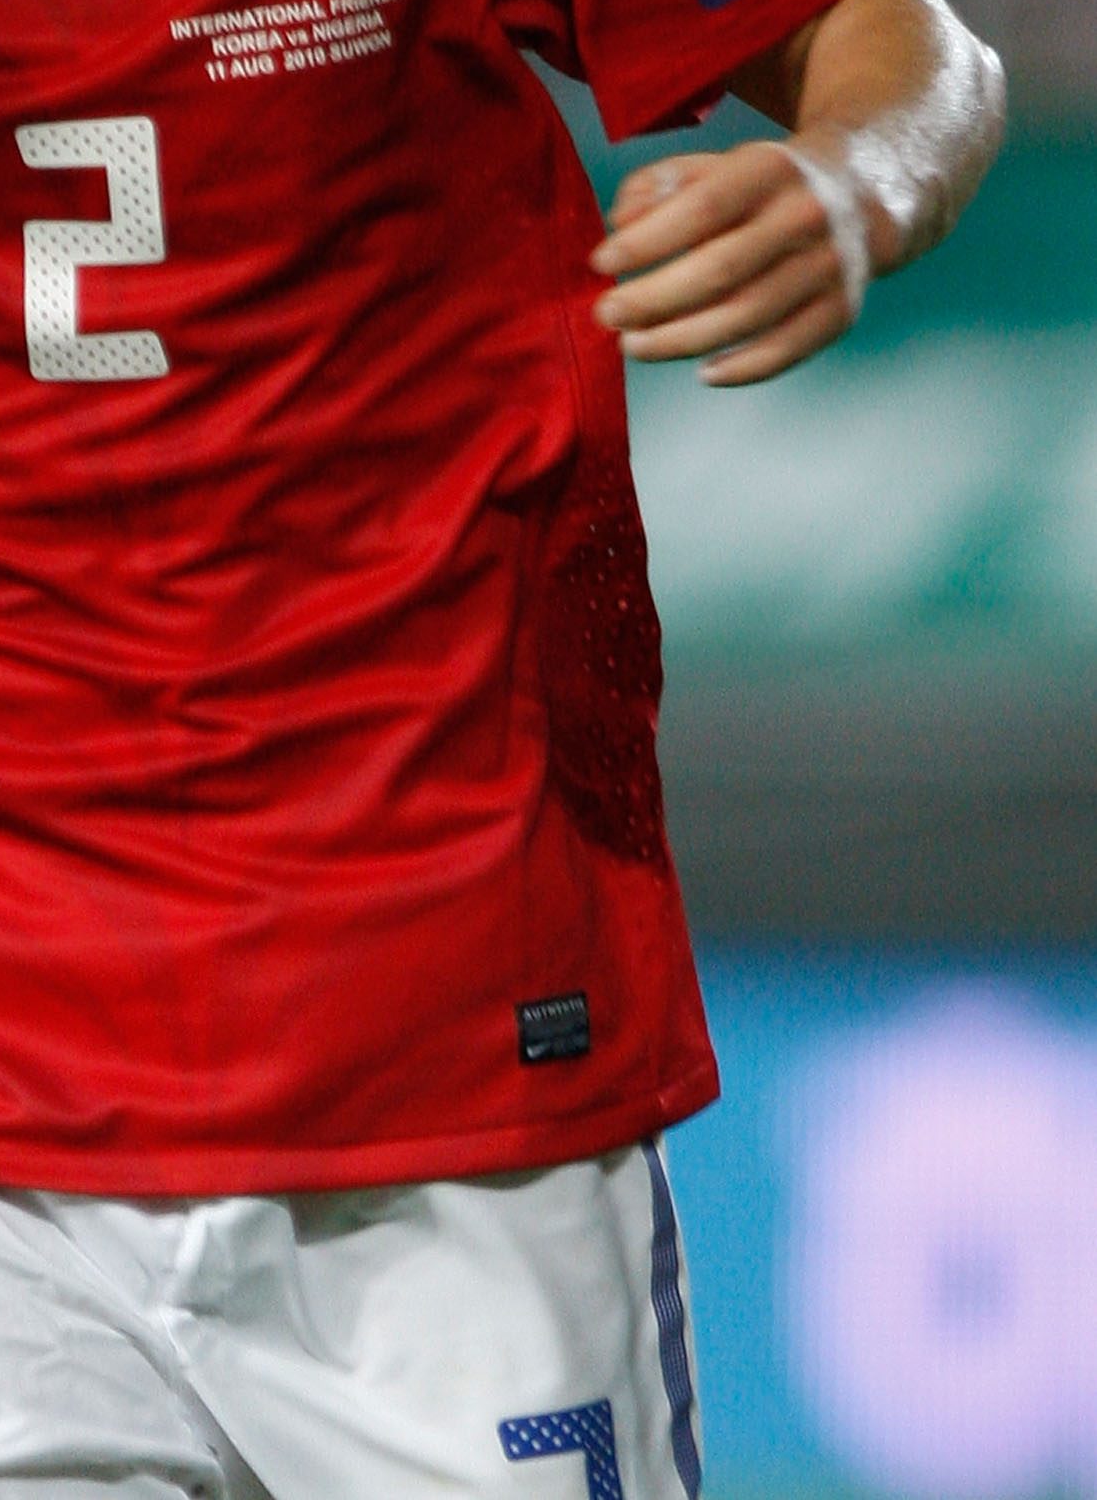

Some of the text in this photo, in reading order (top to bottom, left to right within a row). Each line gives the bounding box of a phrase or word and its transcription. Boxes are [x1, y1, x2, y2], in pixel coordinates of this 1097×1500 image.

[204, 29, 392, 82] 11 AUG 2010 SUWON
[211, 29, 284, 57] KOREA
[312, 9, 384, 42] NIGERIA
[14, 115, 170, 382] 2
